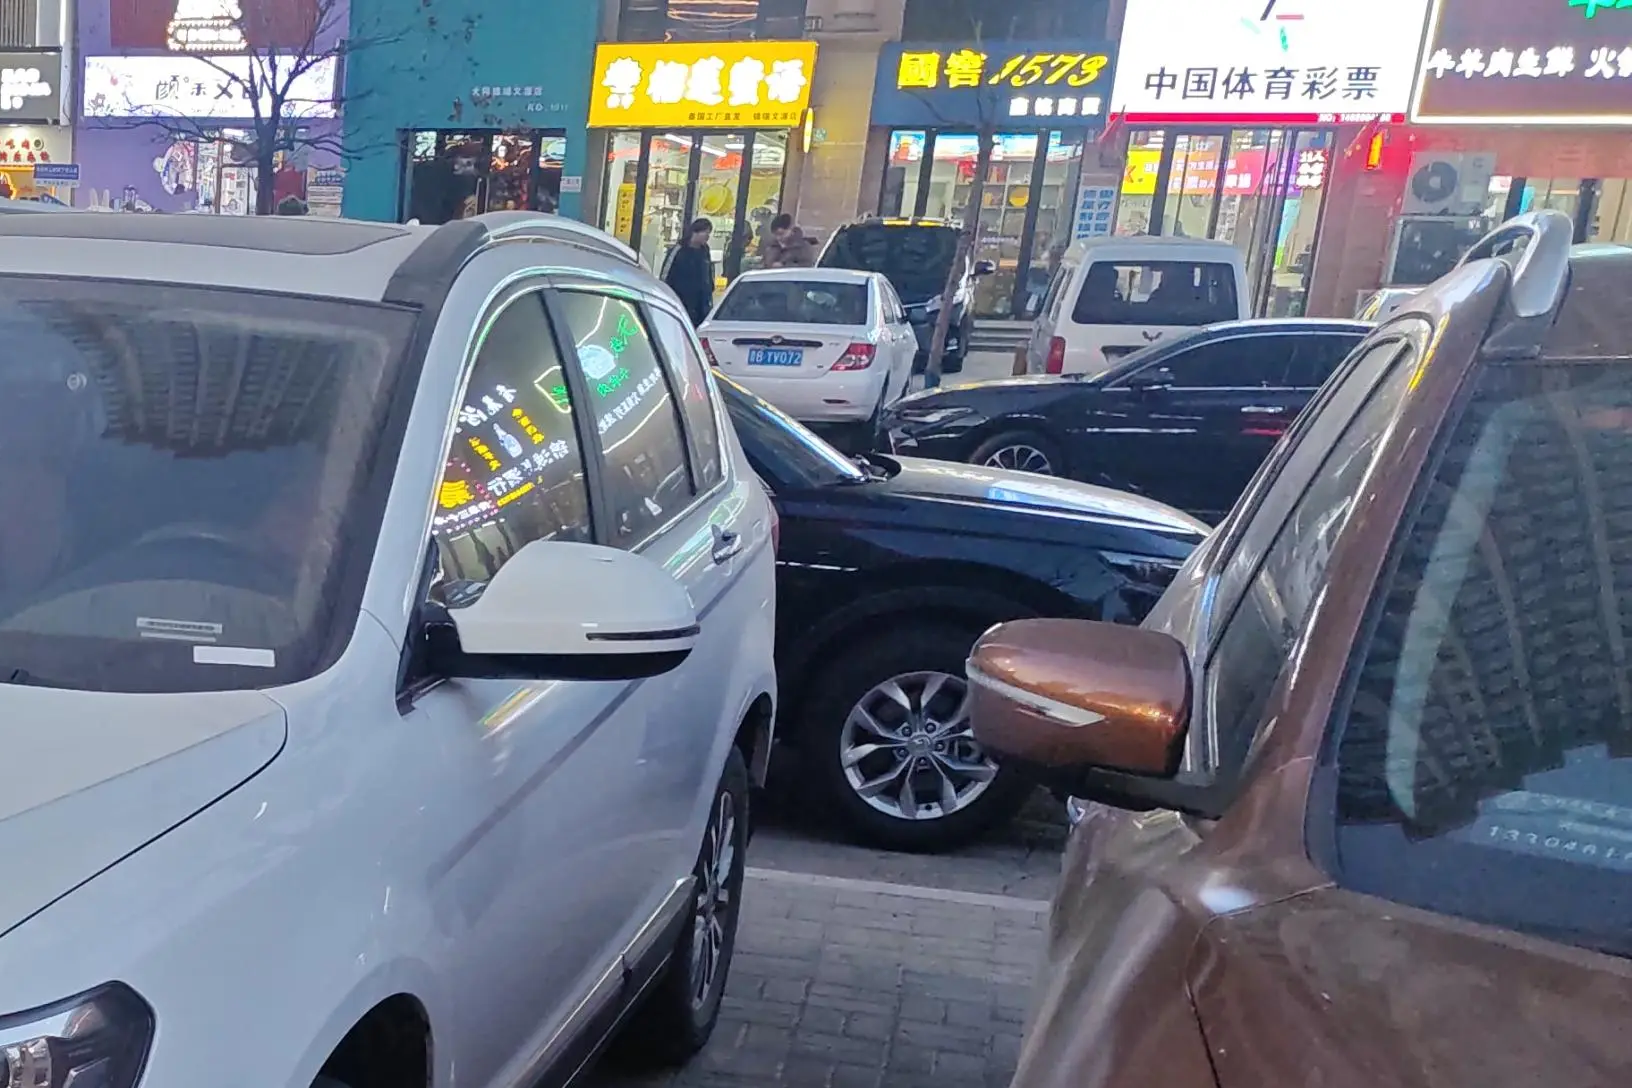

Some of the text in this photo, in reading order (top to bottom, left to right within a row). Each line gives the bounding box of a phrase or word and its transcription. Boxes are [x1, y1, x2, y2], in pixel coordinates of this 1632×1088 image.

[1144, 66, 1382, 100] 中国体育彩票
